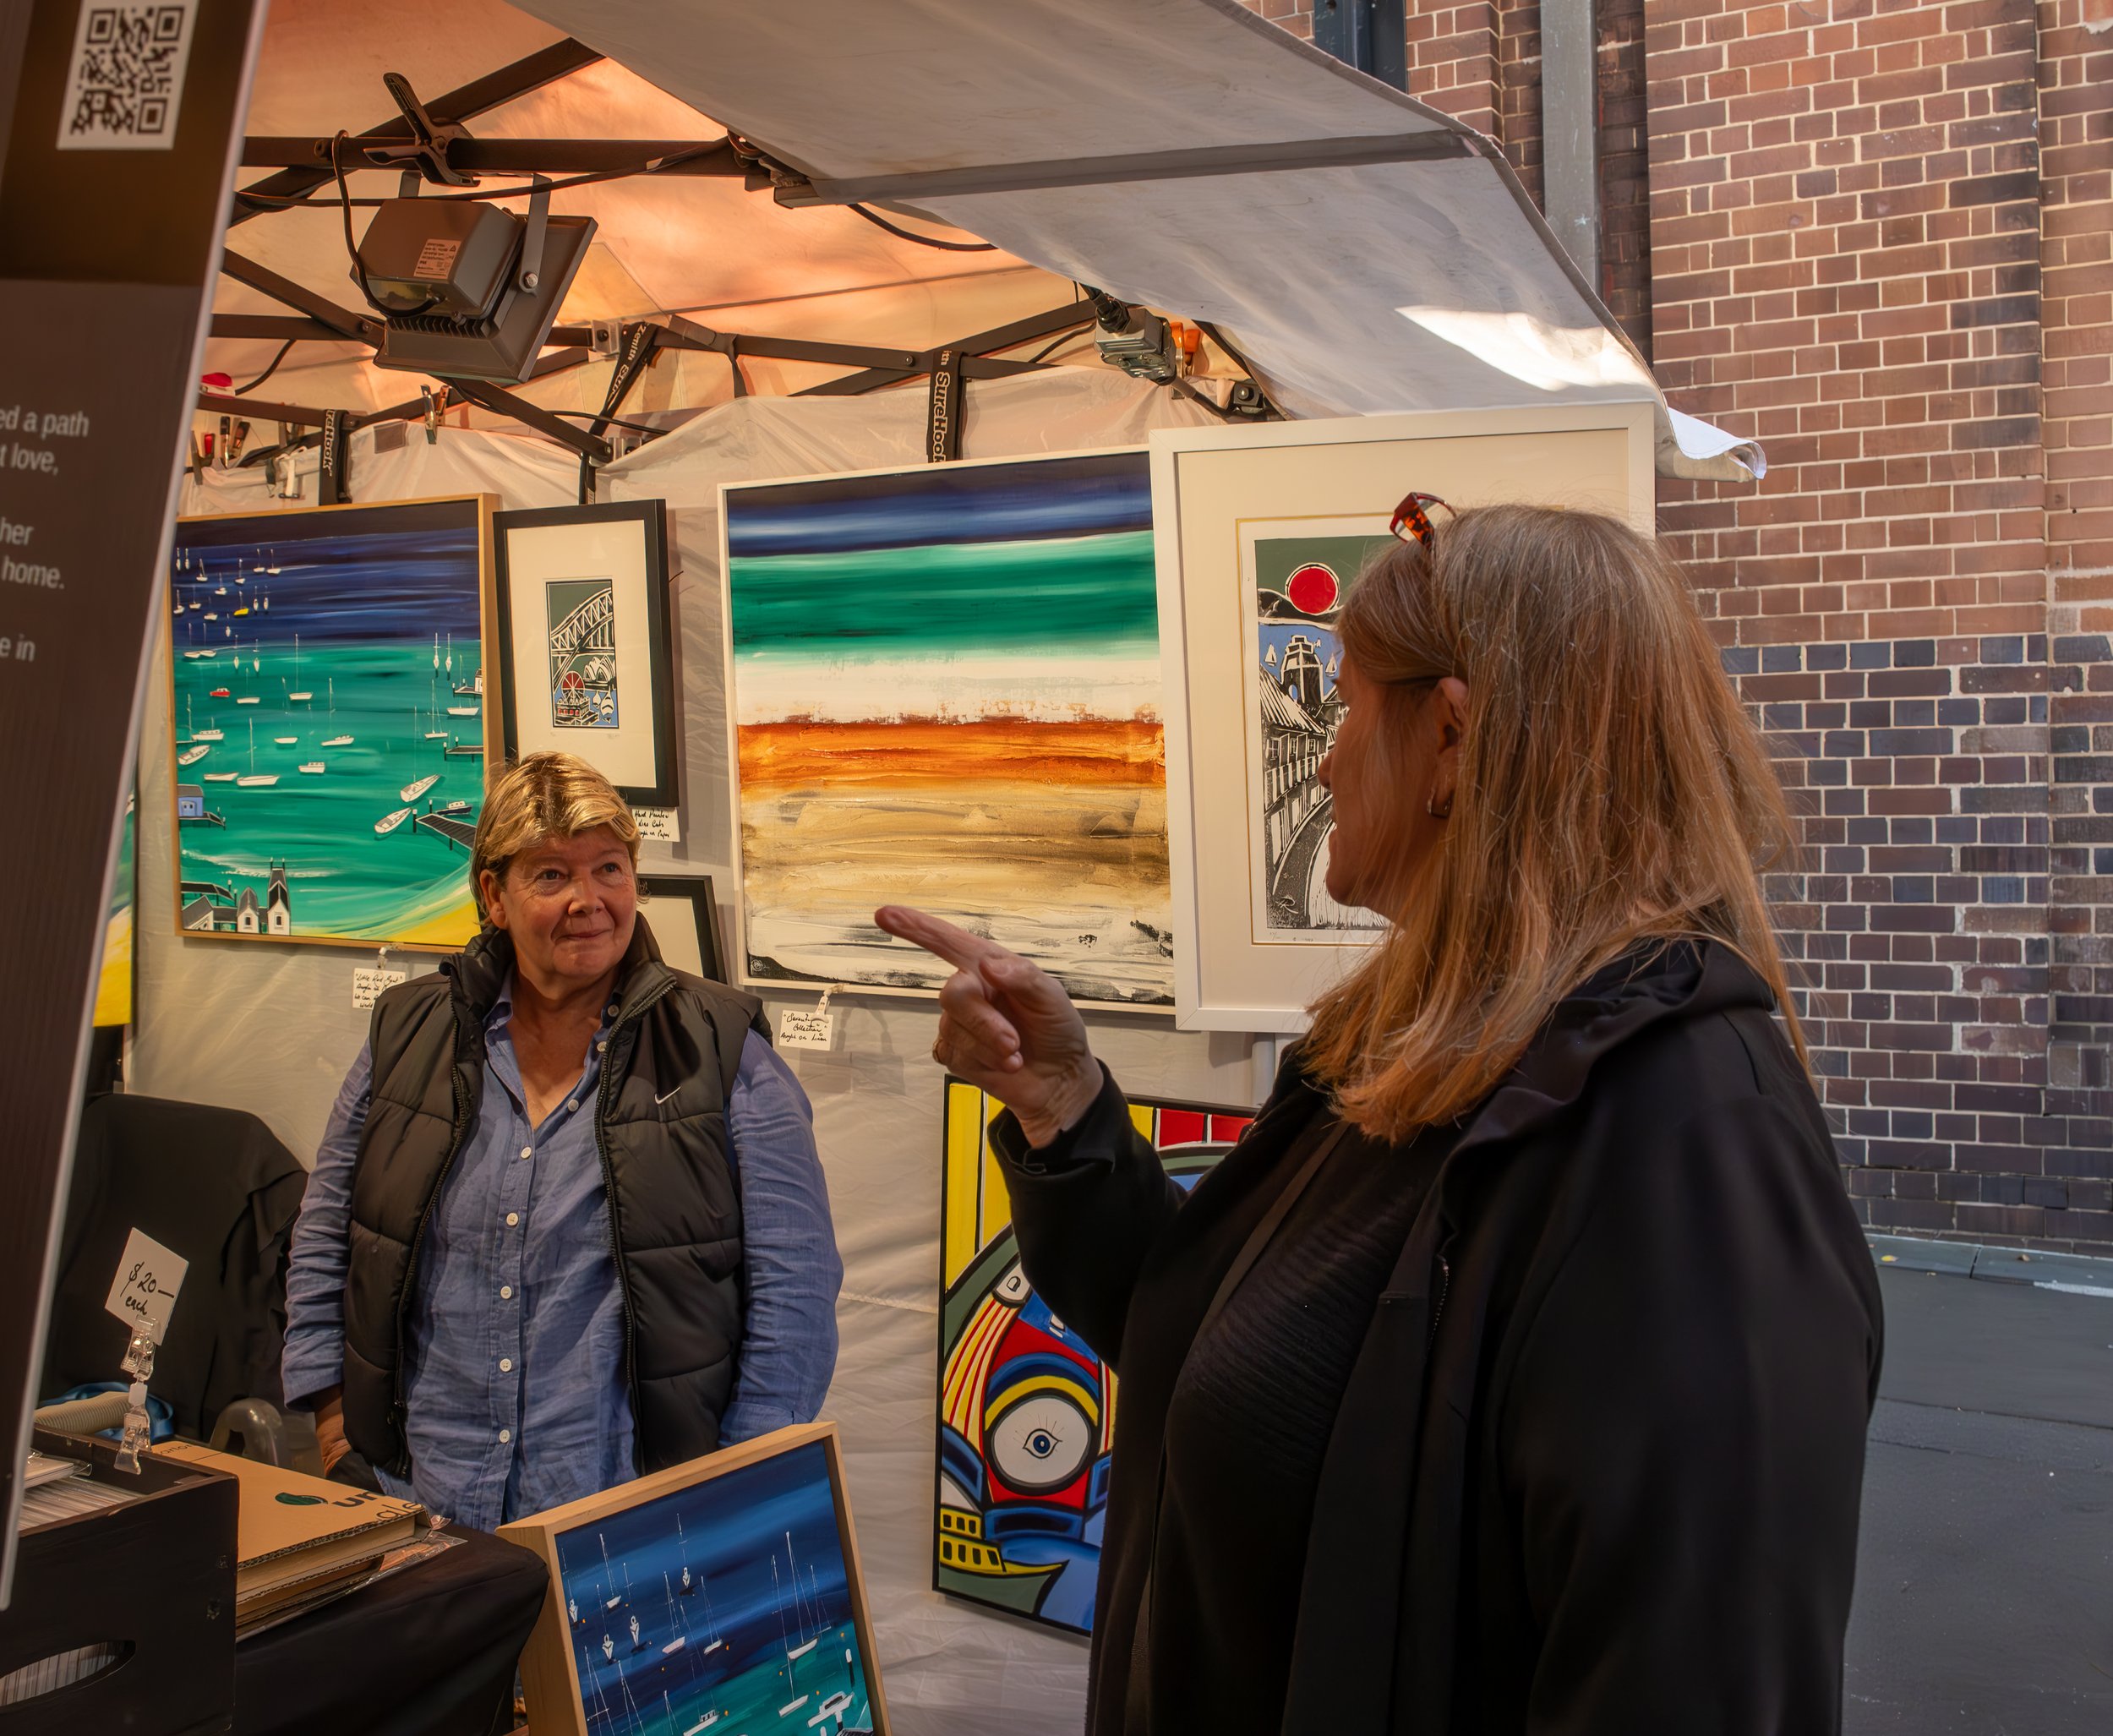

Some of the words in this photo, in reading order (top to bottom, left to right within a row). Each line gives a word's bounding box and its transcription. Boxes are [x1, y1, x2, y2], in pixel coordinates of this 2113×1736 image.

[23, 411, 38, 433] a
[41, 410, 90, 440] path
[10, 441, 59, 477] love,
[2, 554, 65, 590] home.
[15, 633, 35, 663] in
[125, 1296, 148, 1316] each
